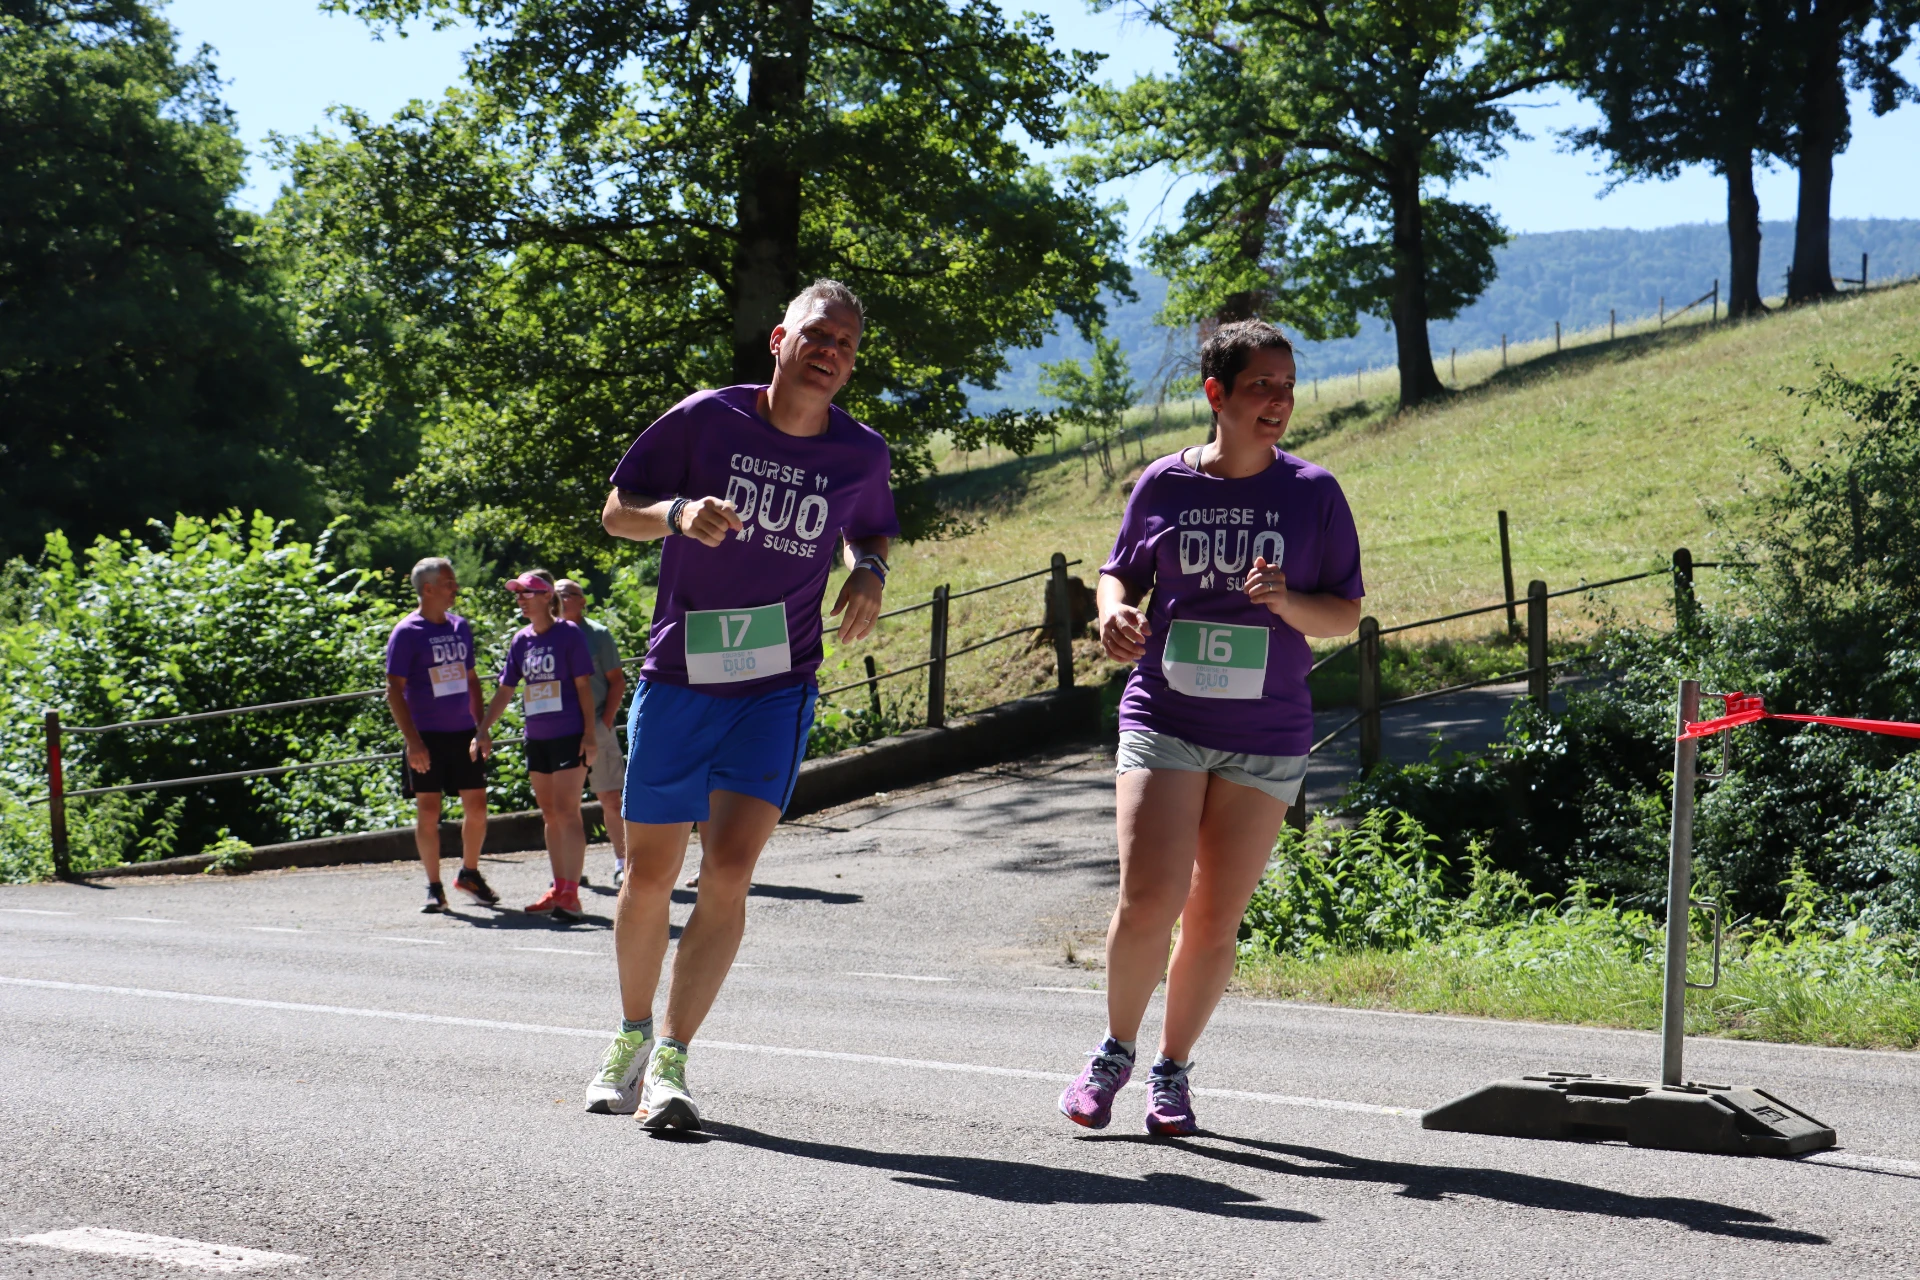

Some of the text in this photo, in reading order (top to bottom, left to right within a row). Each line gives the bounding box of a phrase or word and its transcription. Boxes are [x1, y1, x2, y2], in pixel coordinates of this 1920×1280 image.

[730, 453, 805, 486] COURSE
[725, 475, 828, 541] DUO
[1178, 508, 1254, 526] COURSE
[763, 534, 818, 558] SUISSE
[1179, 529, 1285, 574] DUO
[718, 614, 752, 648] 17
[433, 643, 468, 662] DUO
[1197, 627, 1233, 663] 16
[439, 666, 461, 681] 155
[722, 656, 756, 673] DUO
[1195, 672, 1229, 688] DUO
[530, 685, 552, 700] 154
